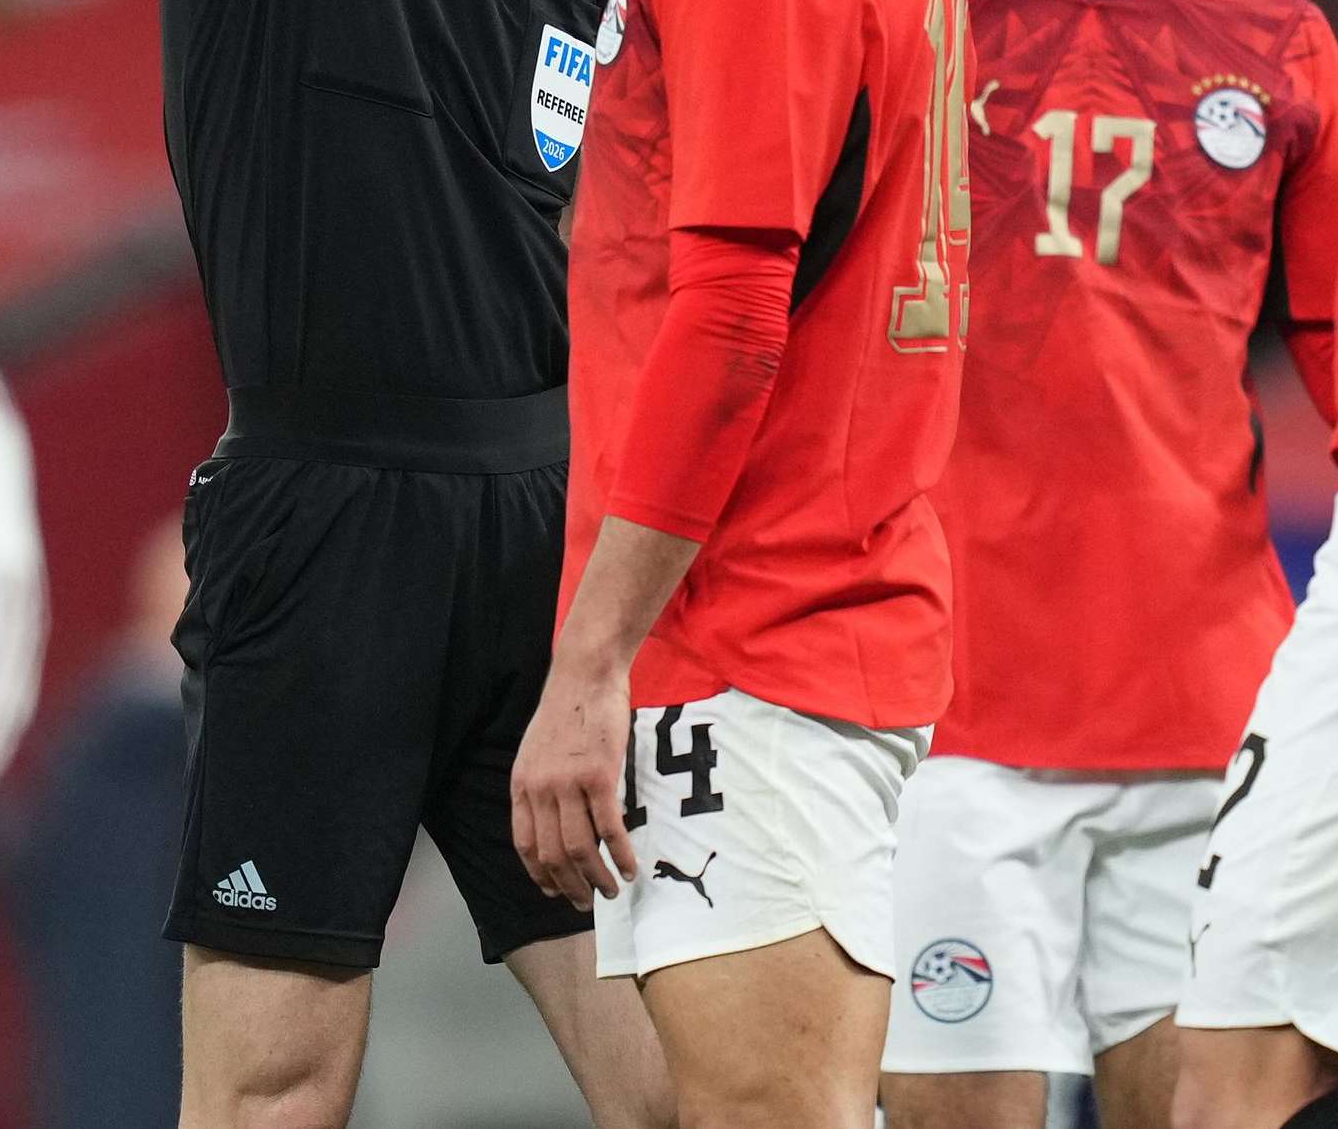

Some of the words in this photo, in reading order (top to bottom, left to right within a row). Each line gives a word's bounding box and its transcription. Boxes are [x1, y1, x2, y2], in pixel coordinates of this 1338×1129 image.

[544, 36, 590, 87] FIFA
[537, 88, 585, 125] REFEREE
[1033, 110, 1156, 265] 17
[212, 888, 277, 911] adidas
